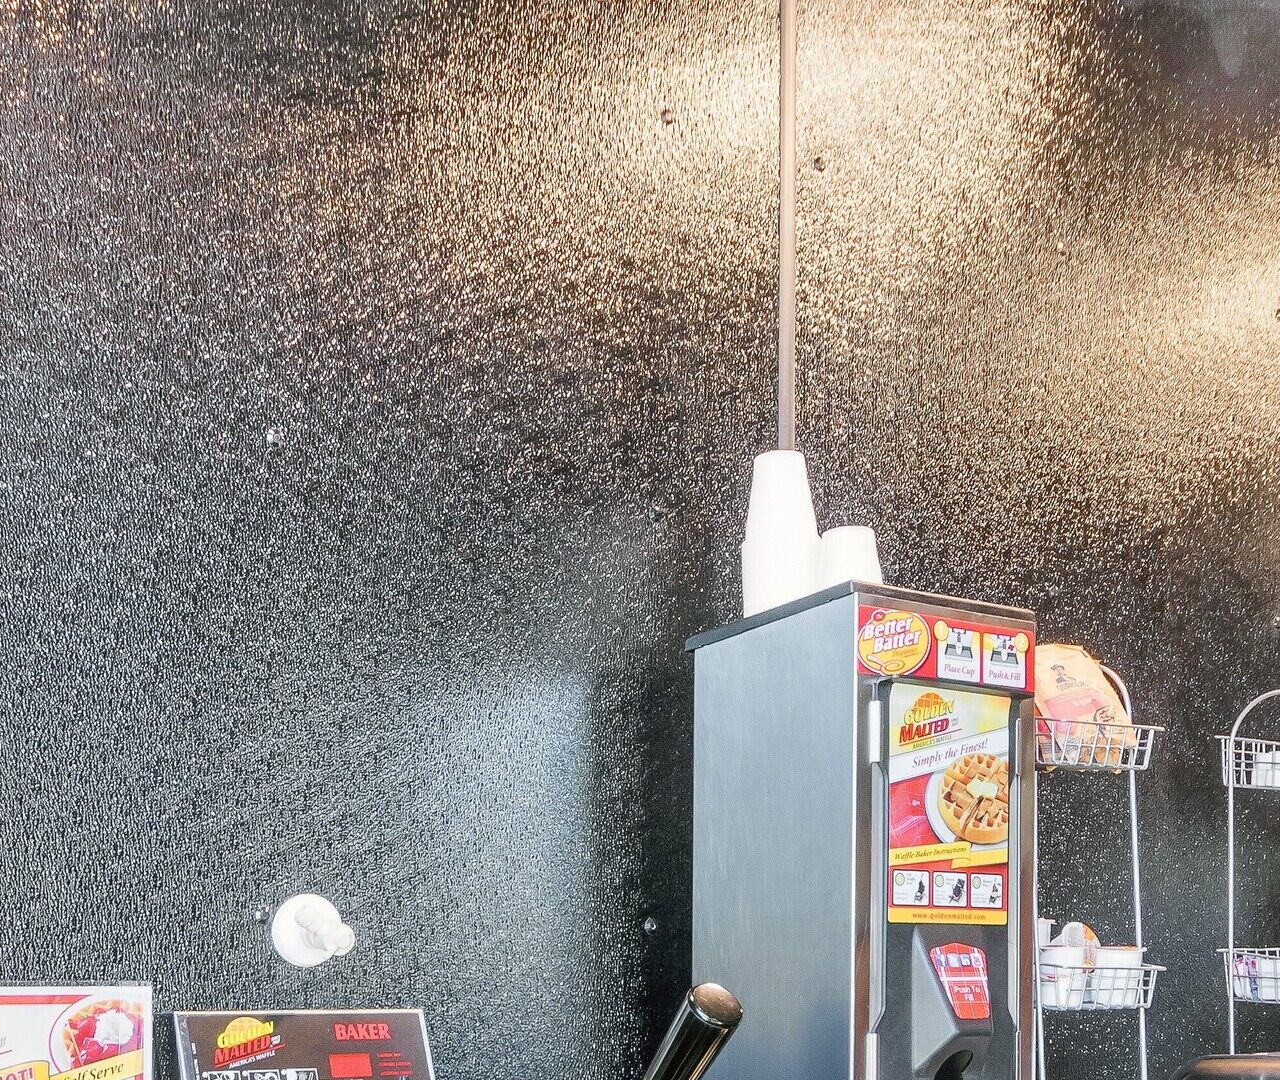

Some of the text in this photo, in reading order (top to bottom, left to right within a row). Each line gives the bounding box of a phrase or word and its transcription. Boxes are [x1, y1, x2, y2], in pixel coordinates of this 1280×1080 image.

[863, 617, 914, 641] Better
[872, 630, 922, 654] Batter
[944, 663, 975, 678] Place Cup
[989, 670, 1004, 678] Push
[1010, 672, 1021, 681] Fill
[904, 700, 955, 725] GOLDEN
[899, 718, 950, 744] MALTED
[912, 738, 988, 768] Simply the Finest!
[895, 847, 967, 861] Waffle Baker Instructions
[335, 1023, 392, 1040] BAKER
[214, 1034, 271, 1063] MALTED
